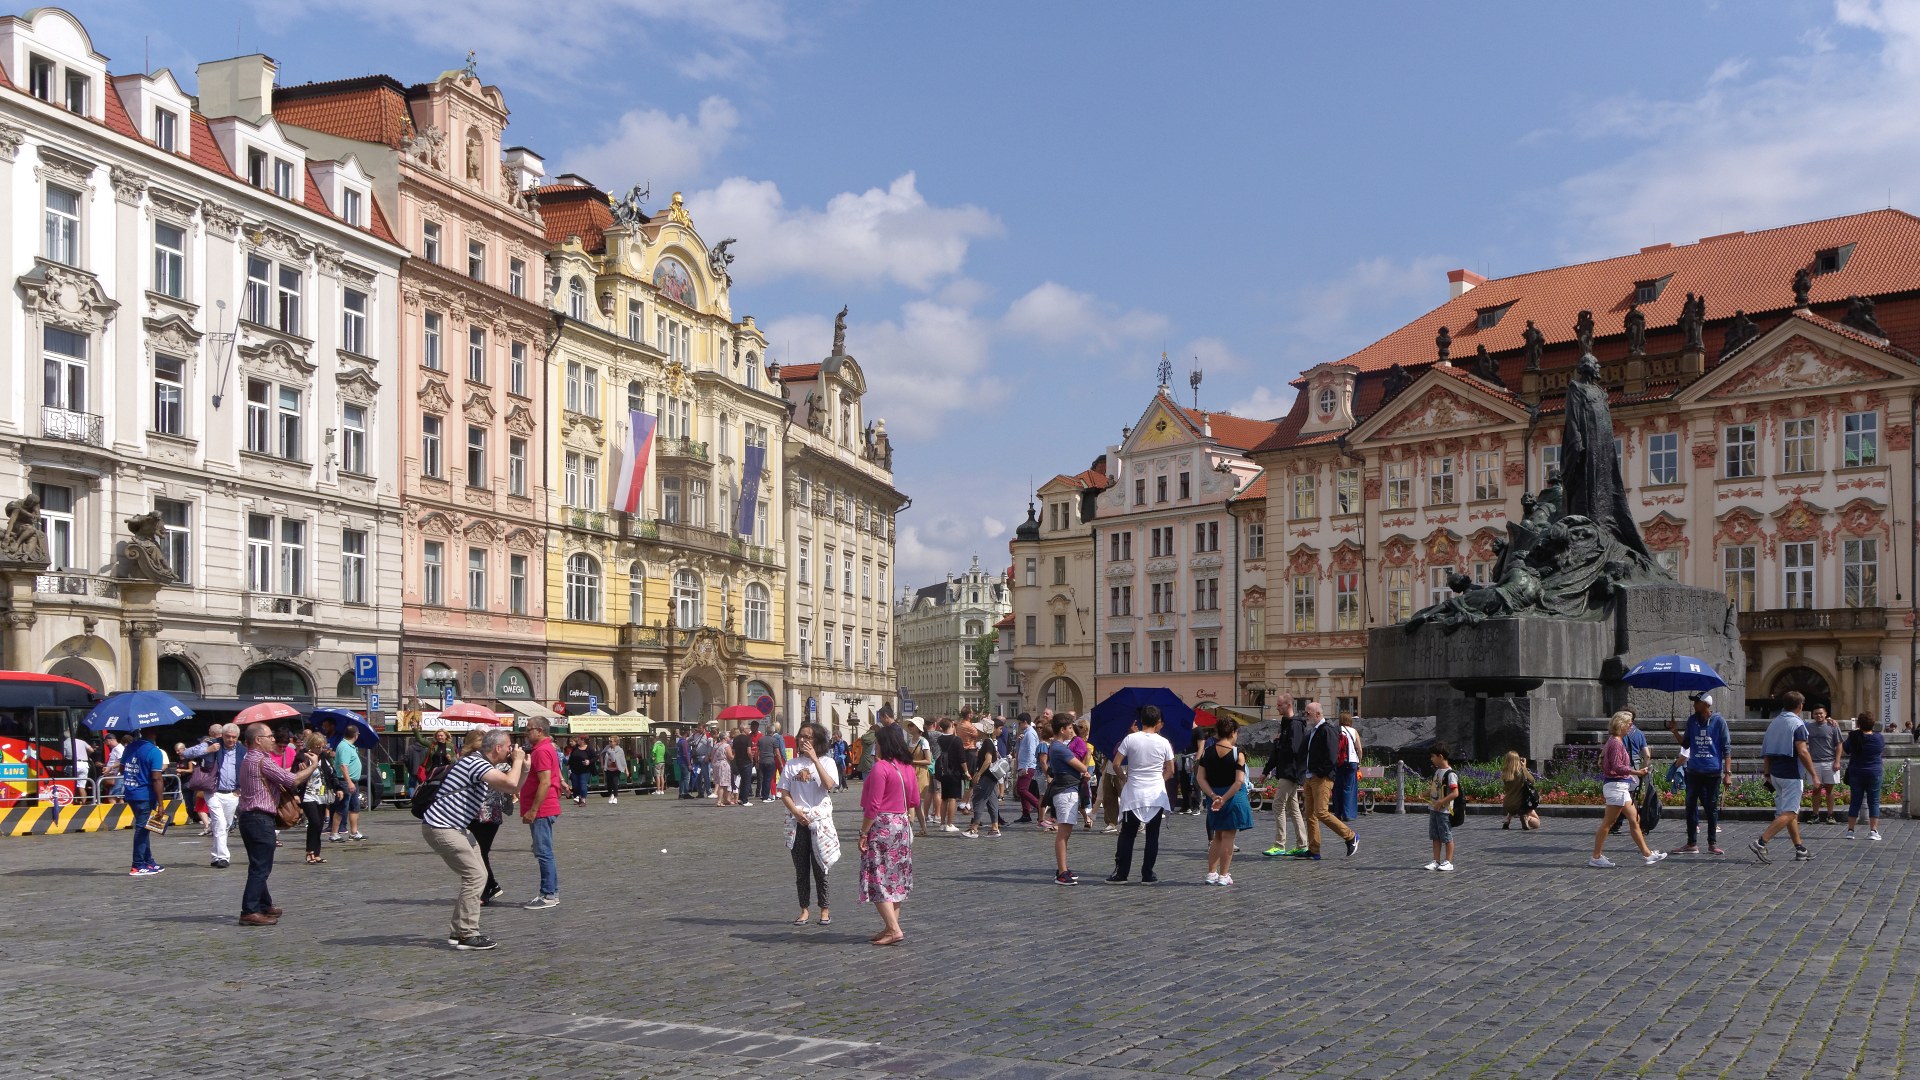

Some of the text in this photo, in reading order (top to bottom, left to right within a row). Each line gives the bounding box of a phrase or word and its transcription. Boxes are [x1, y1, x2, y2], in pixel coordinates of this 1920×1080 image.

[360, 658, 373, 676] P
[503, 685, 525, 693] OMEGA
[3, 767, 25, 775] LINE
